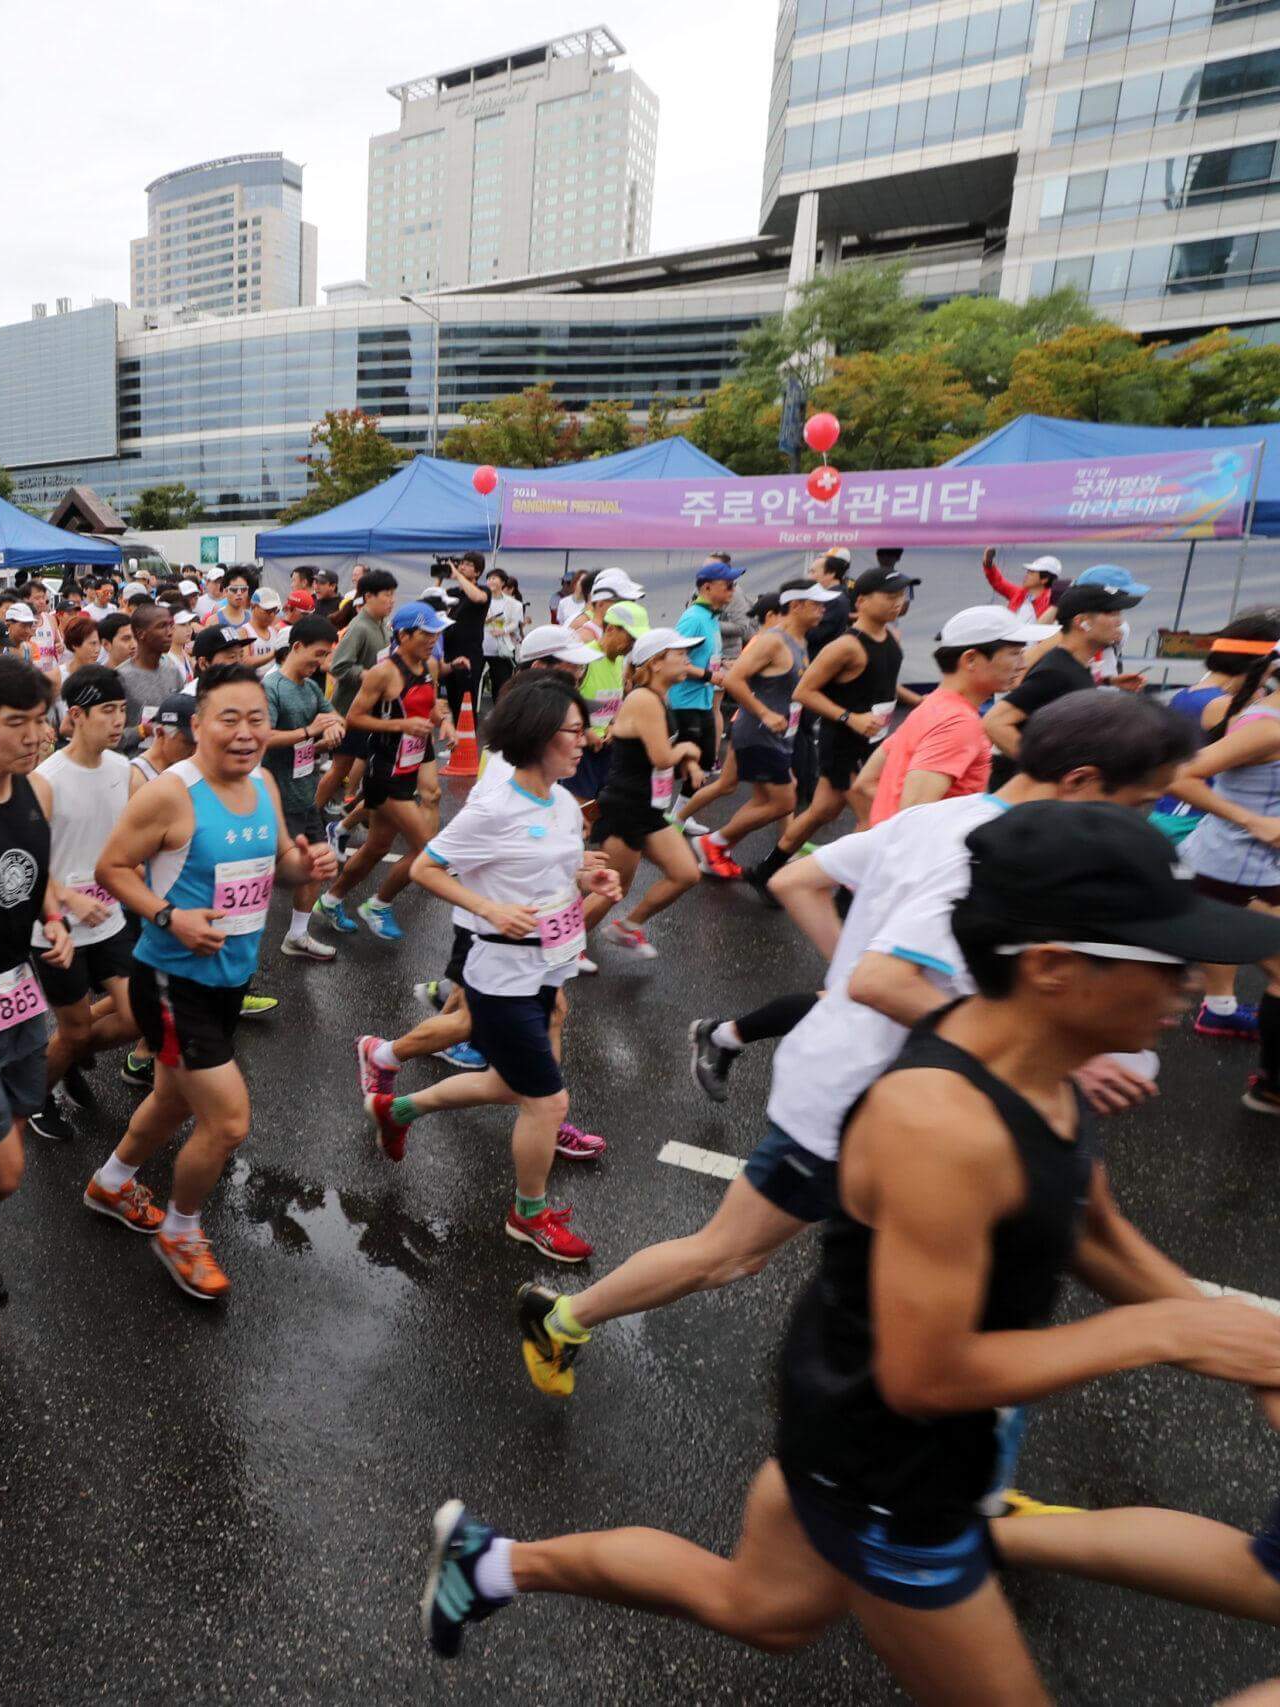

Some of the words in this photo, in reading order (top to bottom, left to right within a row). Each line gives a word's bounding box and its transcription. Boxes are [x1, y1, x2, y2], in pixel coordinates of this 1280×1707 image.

[1072, 475, 1162, 498] 국제평화
[570, 499, 623, 513] FESTIVAL
[1069, 494, 1182, 519] 마라톤대회
[778, 530, 812, 543] Race
[816, 530, 859, 543] Patrol
